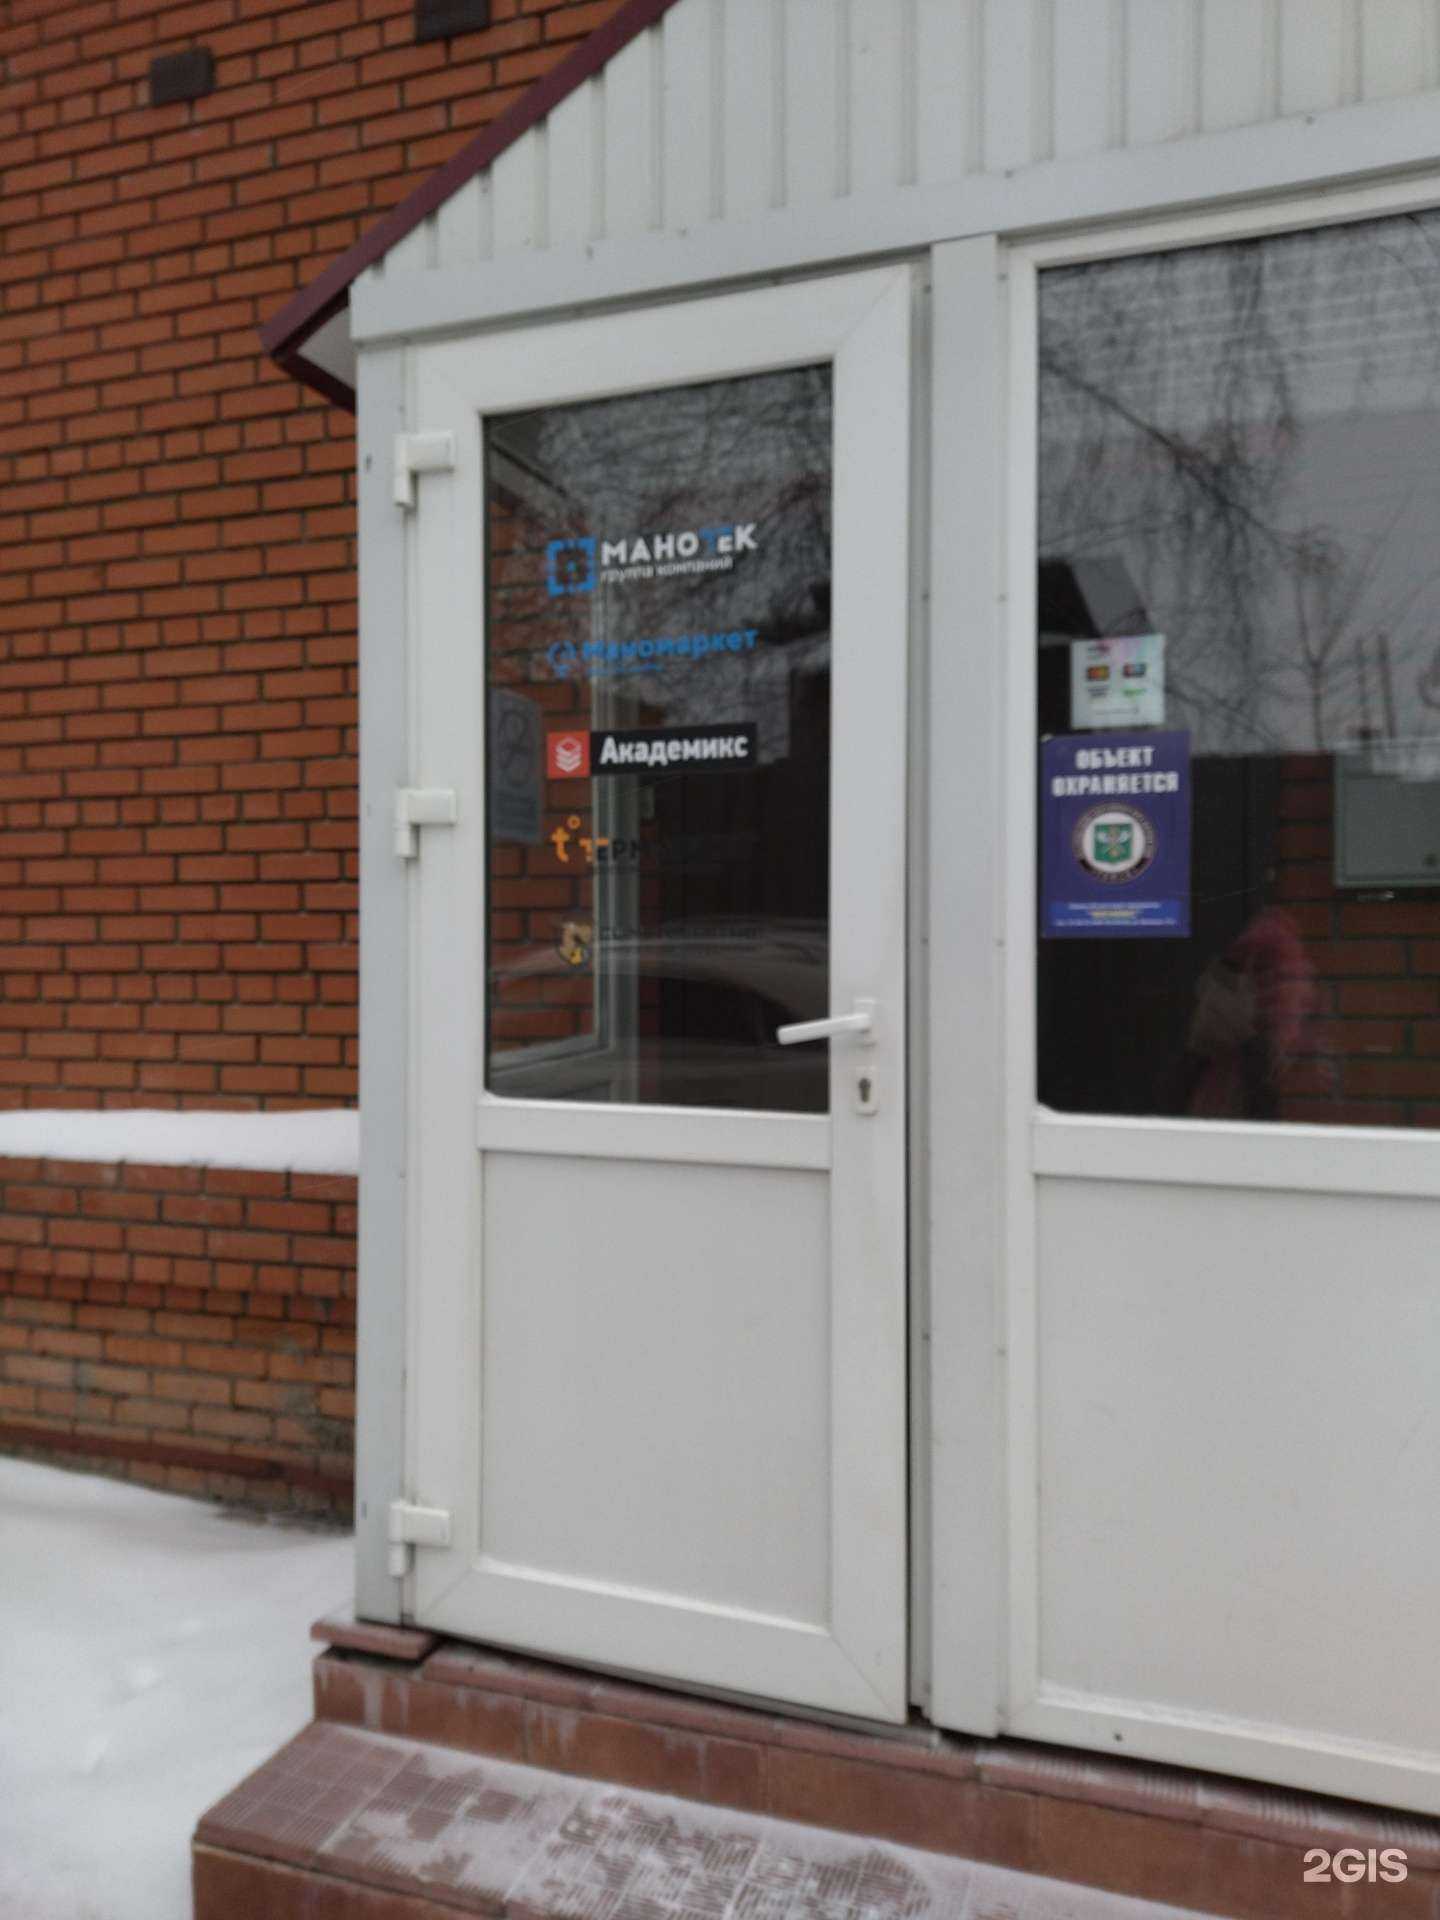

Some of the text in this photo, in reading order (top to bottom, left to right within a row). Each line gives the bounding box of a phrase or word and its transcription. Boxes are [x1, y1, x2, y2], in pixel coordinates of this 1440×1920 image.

[600, 735, 749, 767] Академикс
[1076, 746, 1155, 769] ОБЪЕКТ
[1052, 771, 1180, 797] ОХРАНЯЕТСЯ
